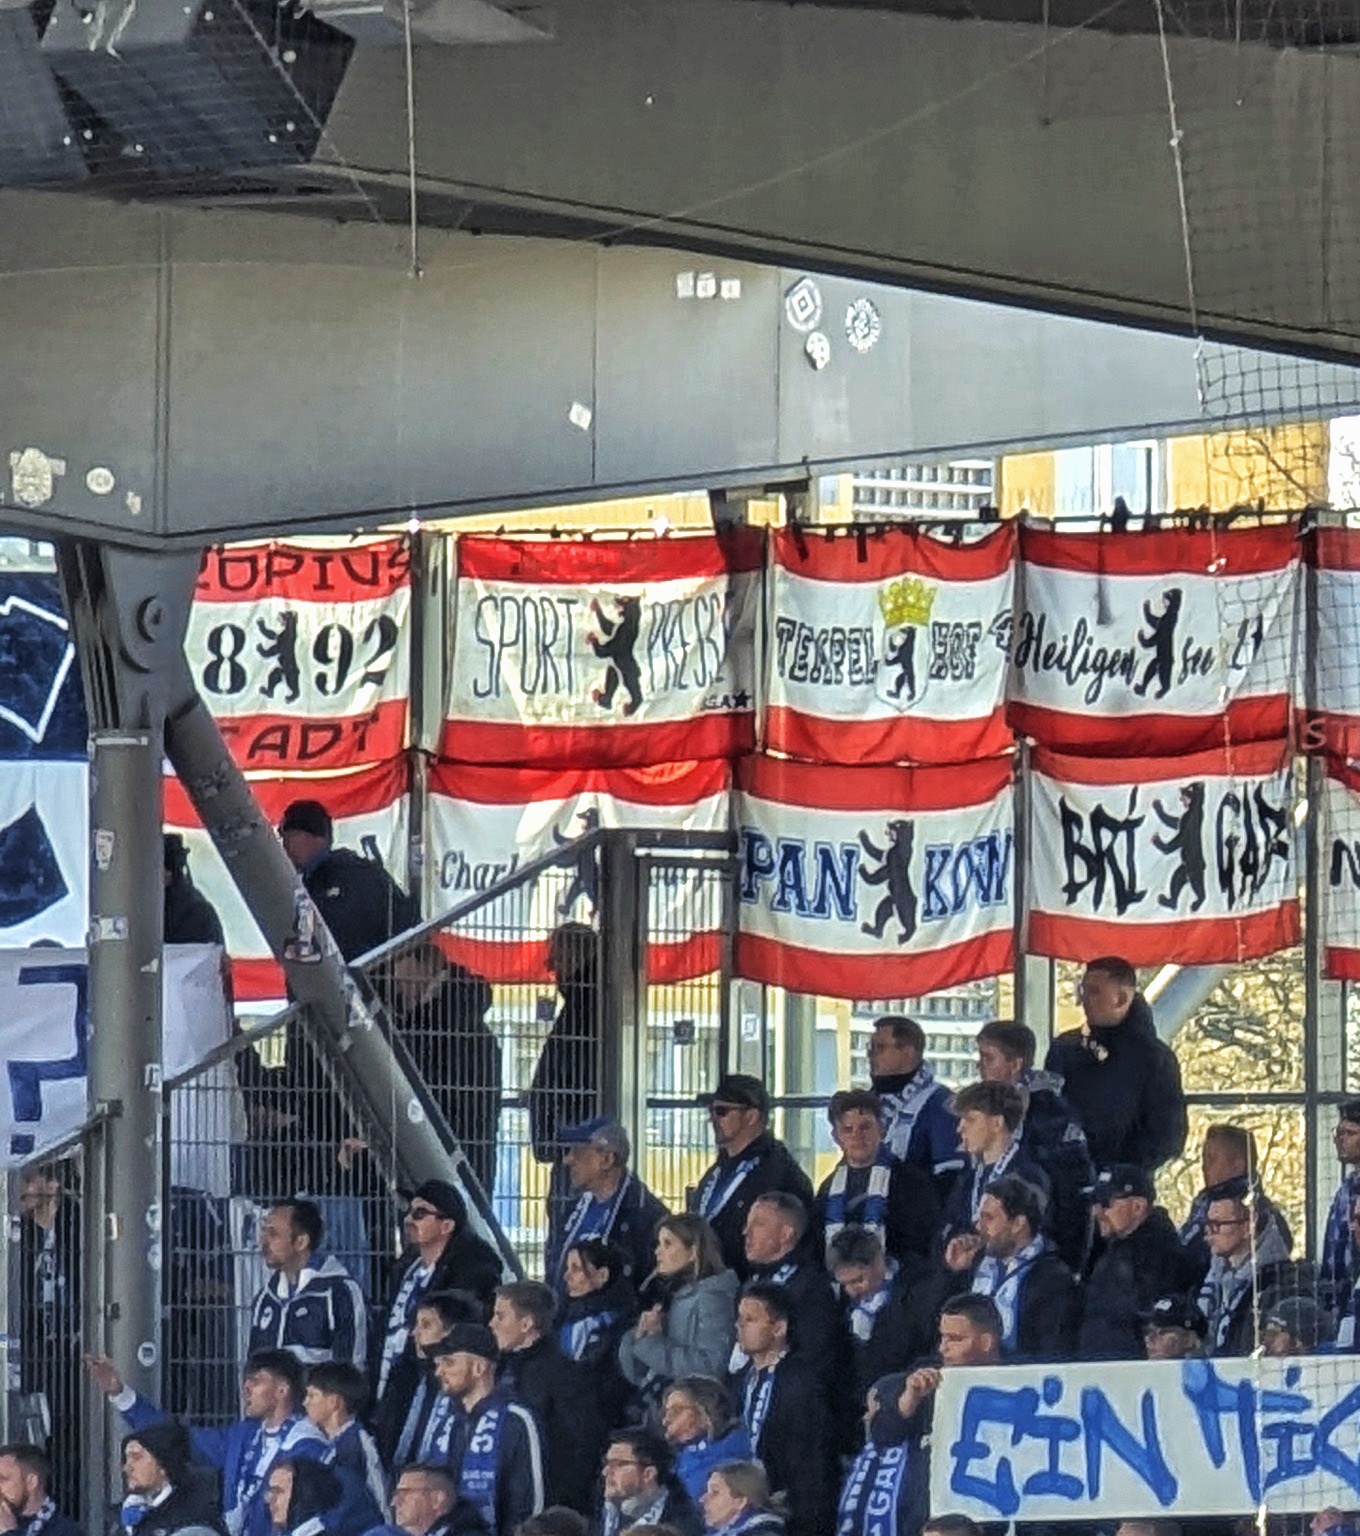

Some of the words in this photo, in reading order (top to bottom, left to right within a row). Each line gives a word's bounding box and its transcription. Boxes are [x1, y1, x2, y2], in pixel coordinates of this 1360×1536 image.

[473, 595, 579, 699] SPORT
[1014, 611, 1137, 705] Heiligen
[739, 825, 859, 924] PAN
[921, 828, 1012, 925] KOW
